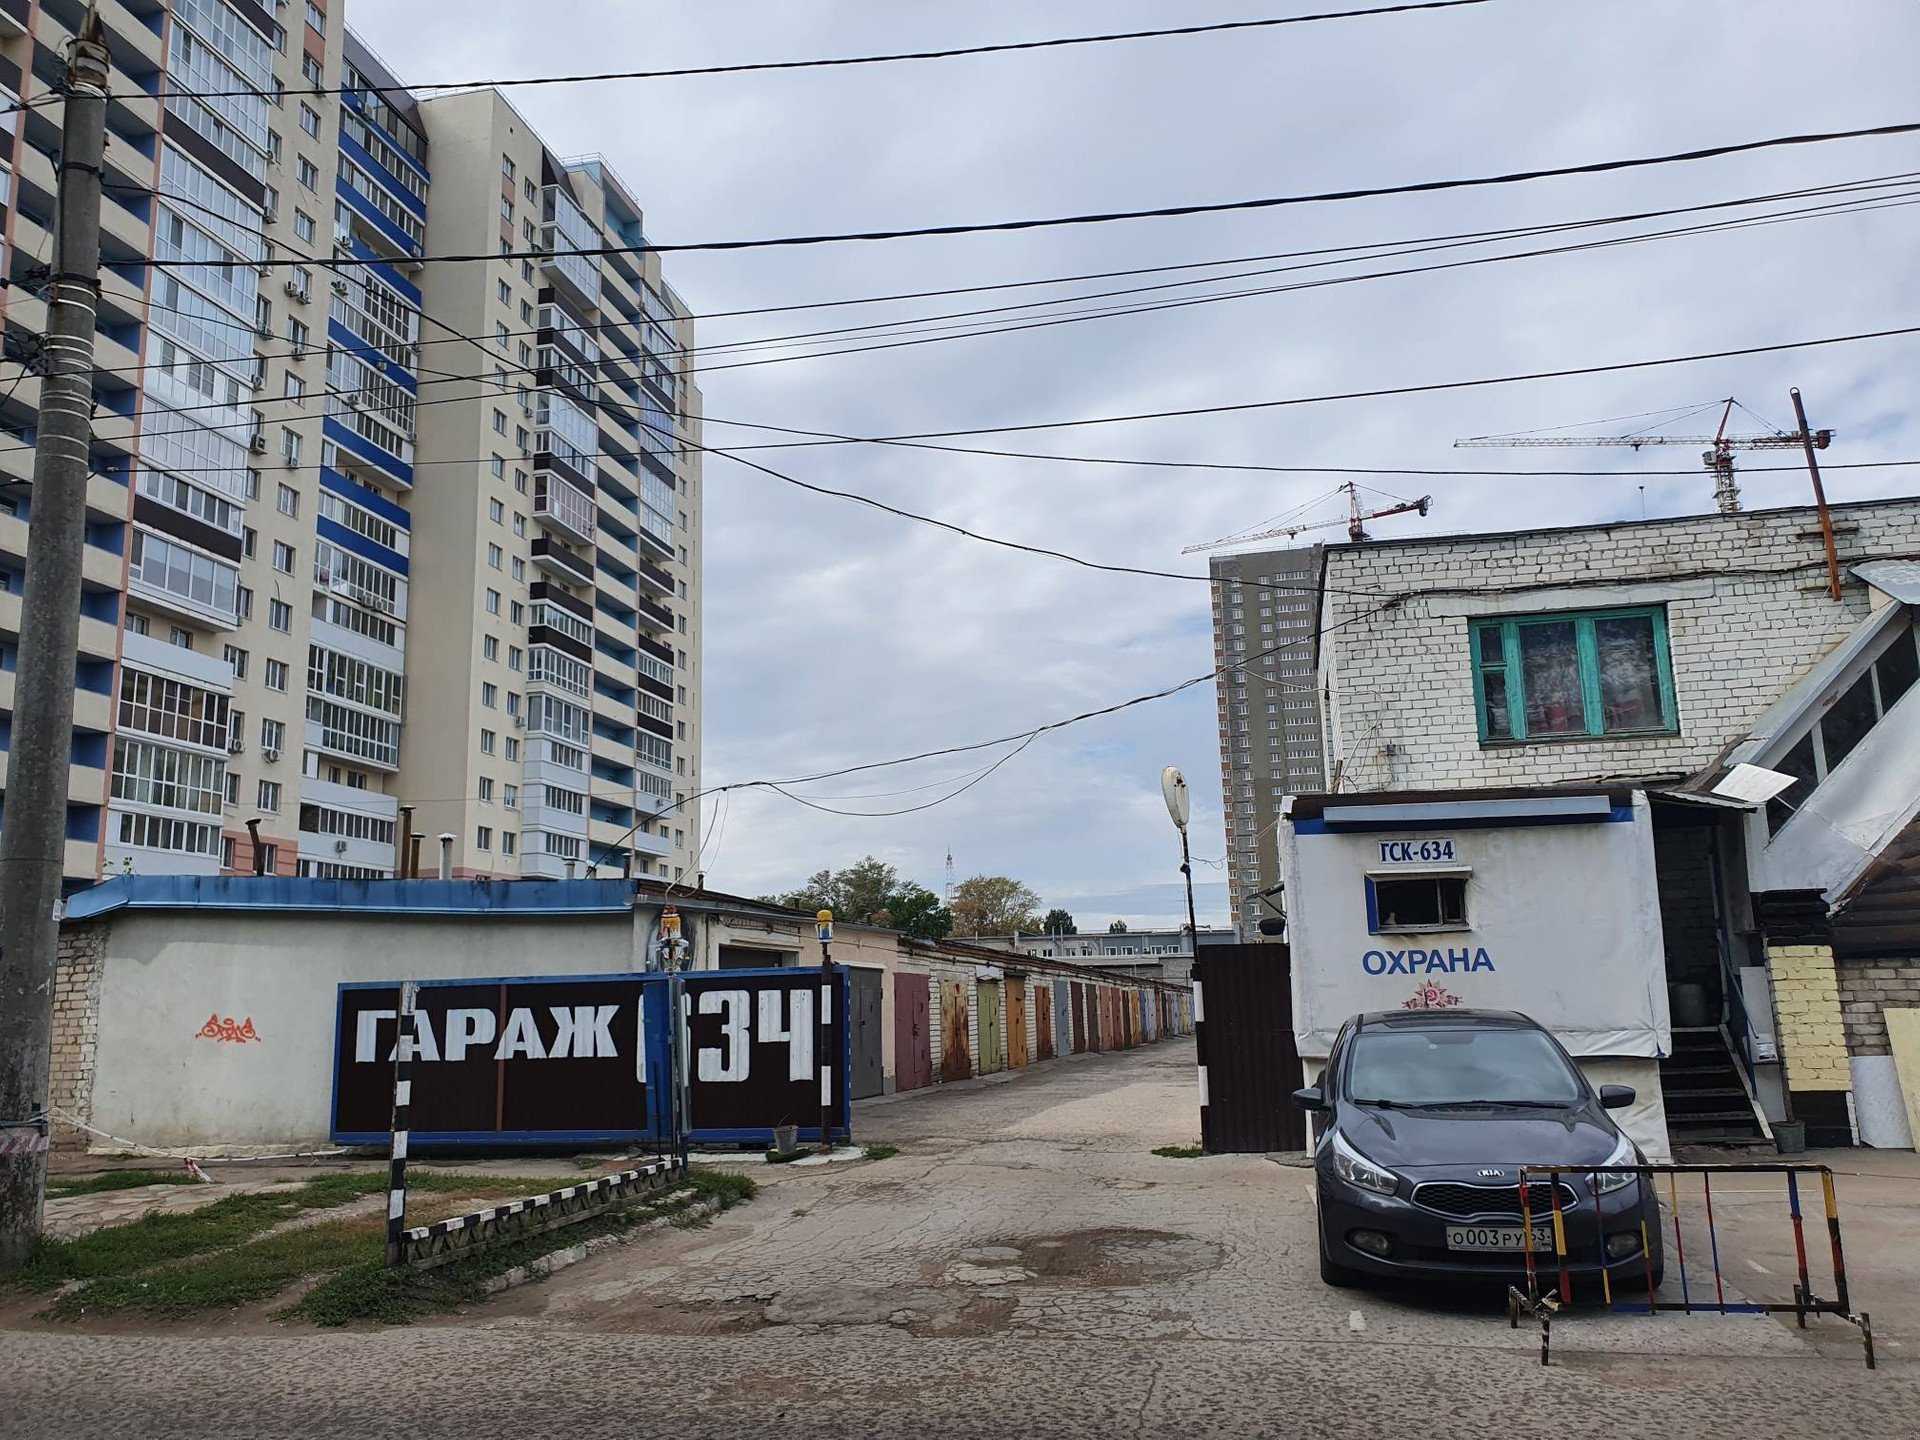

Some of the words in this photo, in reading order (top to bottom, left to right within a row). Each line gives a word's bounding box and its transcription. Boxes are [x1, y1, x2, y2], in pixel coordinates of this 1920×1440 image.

[1380, 841, 1454, 862] ГСК-634
[1362, 947, 1496, 976] ОХРАНА
[355, 1004, 620, 1063] ГАРАЖ
[636, 989, 814, 1083] 34
[1480, 1169, 1502, 1177] KIA
